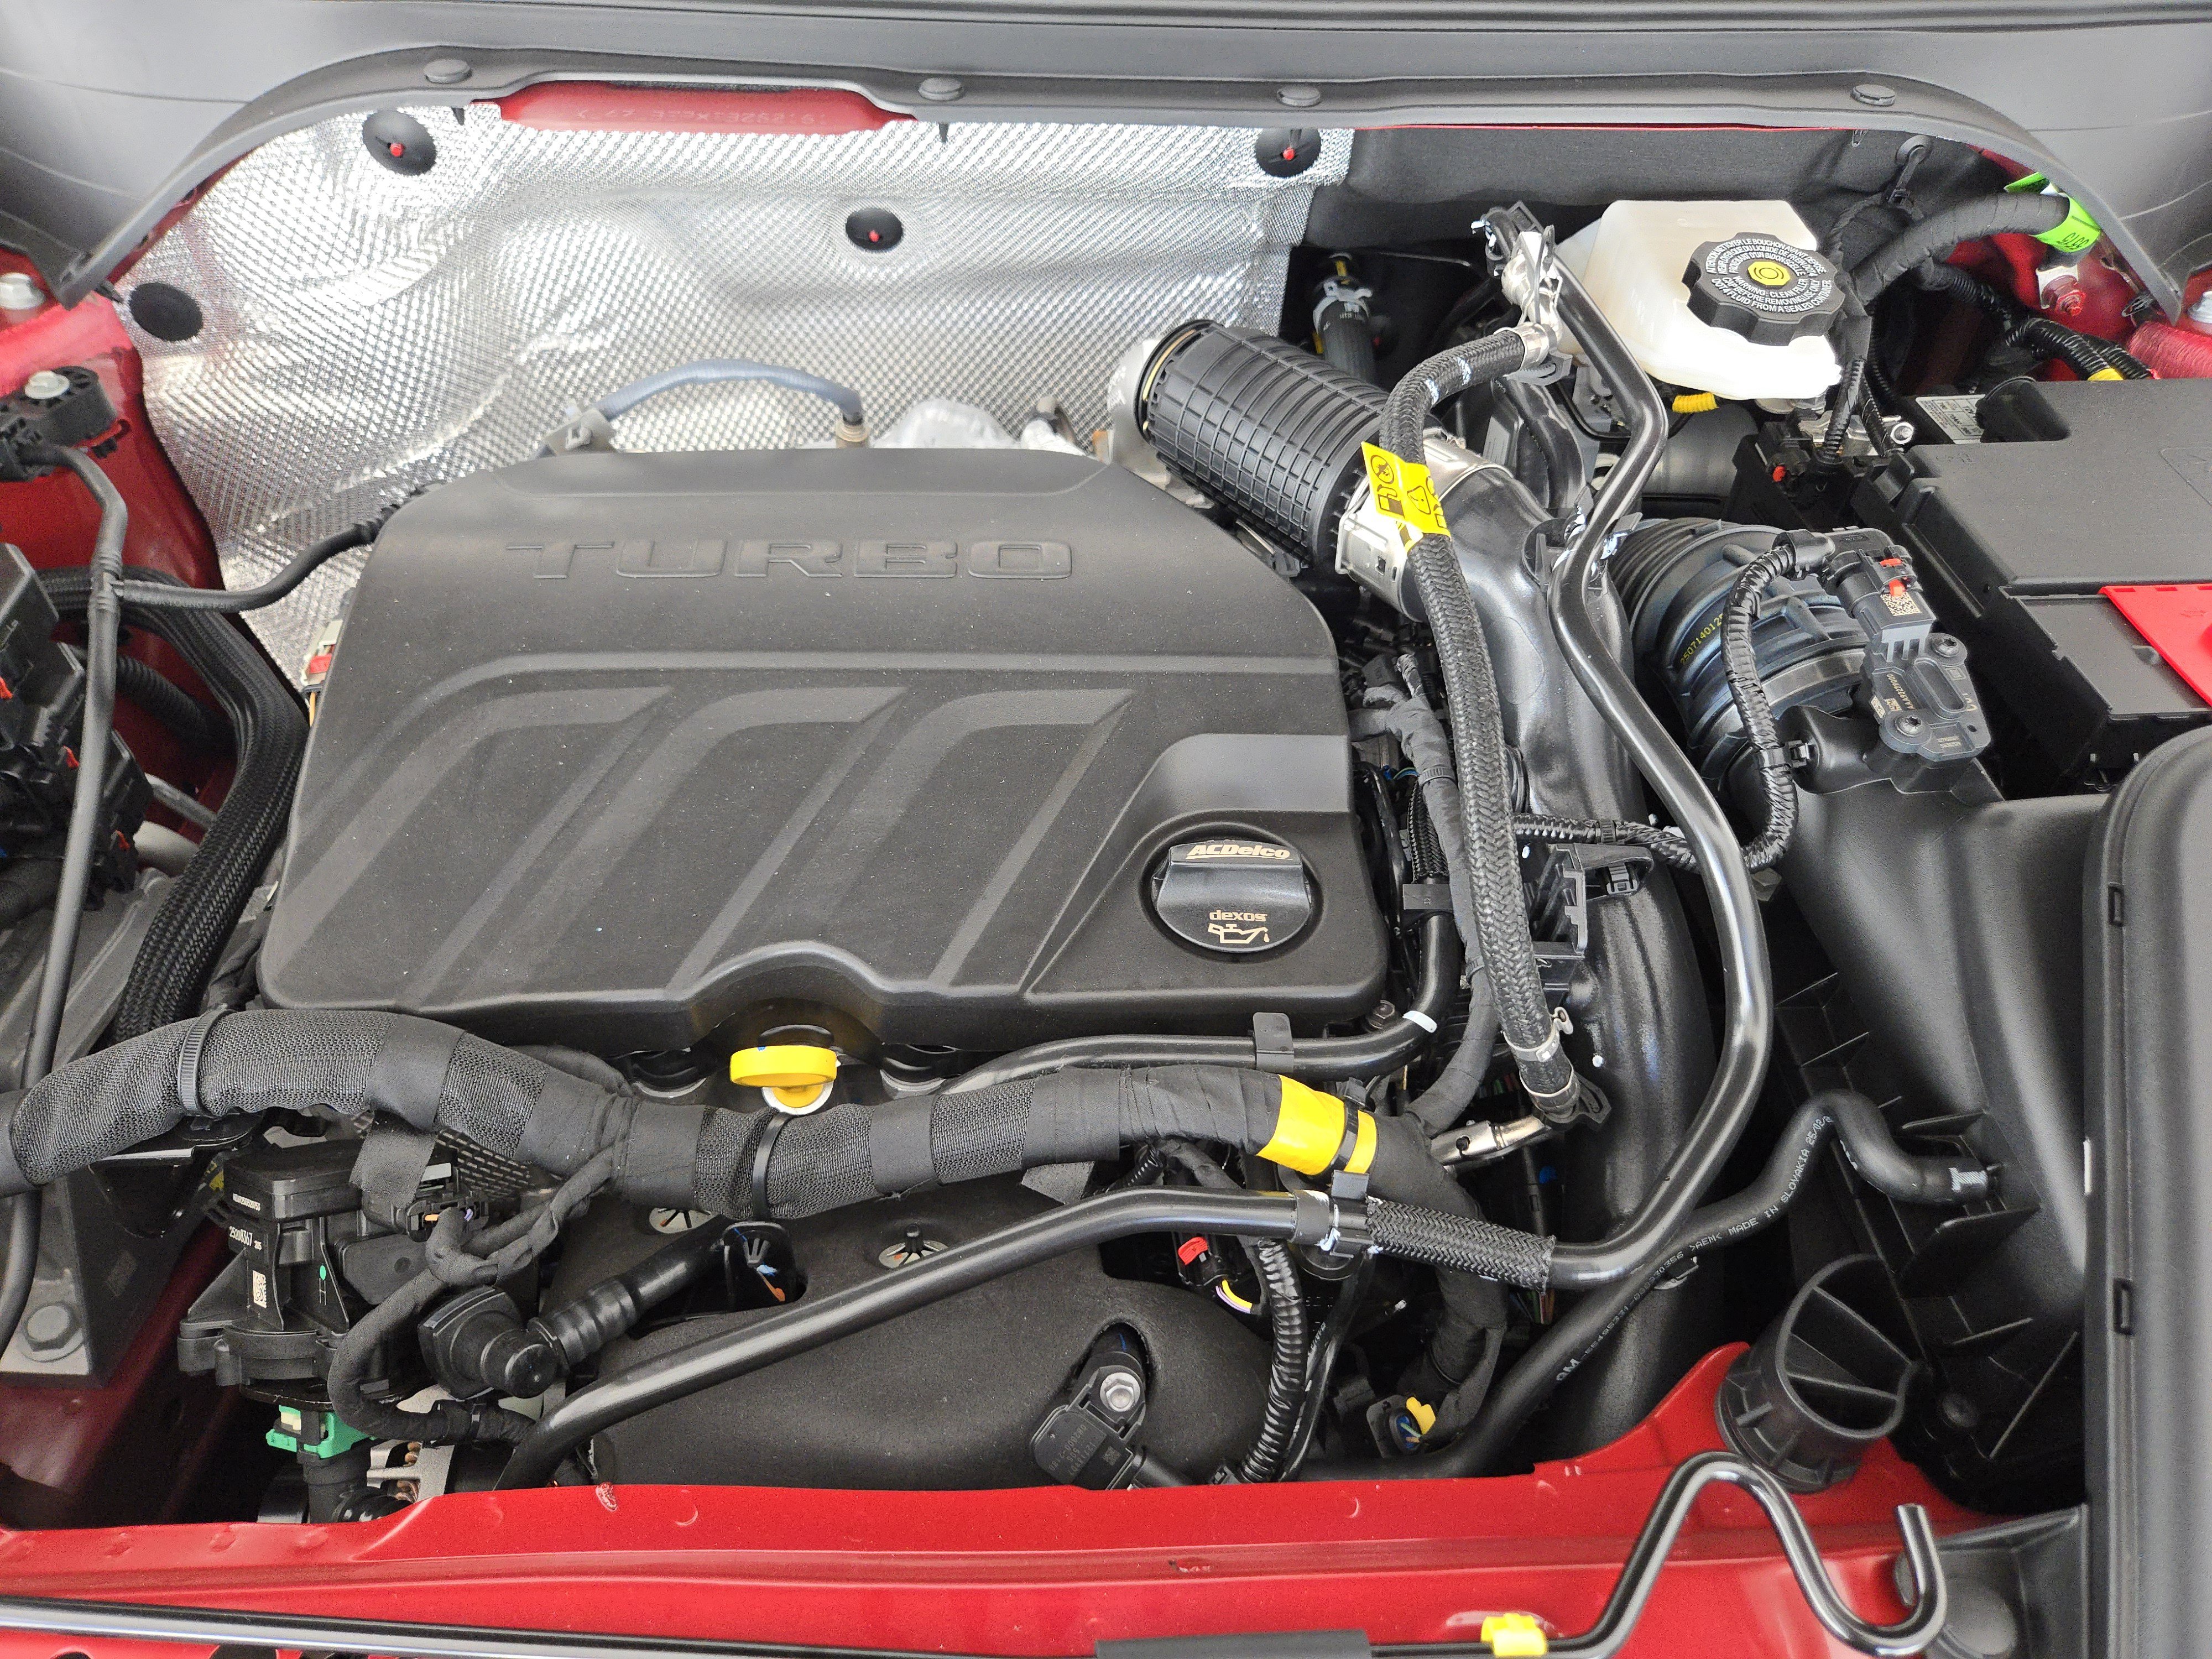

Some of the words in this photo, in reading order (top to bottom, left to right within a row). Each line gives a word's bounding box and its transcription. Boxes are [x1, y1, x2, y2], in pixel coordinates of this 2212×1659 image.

[1752, 238, 1786, 249] BOUCHON
[1784, 246, 1809, 258] AVANT
[1730, 246, 1745, 255] QUE
[1751, 245, 1780, 254] LIQUIDE
[1778, 249, 1790, 257] DE
[1787, 253, 1808, 266] FREIN
[1802, 264, 1818, 276] DOT4
[1765, 252, 1786, 263] BIDON
[1722, 277, 1738, 288] CAP
[1770, 289, 1797, 298] CLEAN
[1792, 278, 1809, 294] FILLER
[1809, 278, 1820, 293] ONLY
[1711, 278, 1732, 294] DOT4
[1726, 290, 1751, 305] FLUID
[1751, 300, 1777, 312] FROM
[1783, 302, 1814, 313] SEALED
[1733, 286, 1765, 302] BEFORE
[1803, 289, 1816, 300] USE
[505, 538, 1073, 580] TURBO
[1186, 844, 1291, 858] ACDelco
[1209, 909, 1268, 922] dexos
[1728, 1218, 1760, 1235] MADE
[1764, 1204, 1779, 1219] IN
[1781, 1148, 1811, 1203] SLOVAKIA
